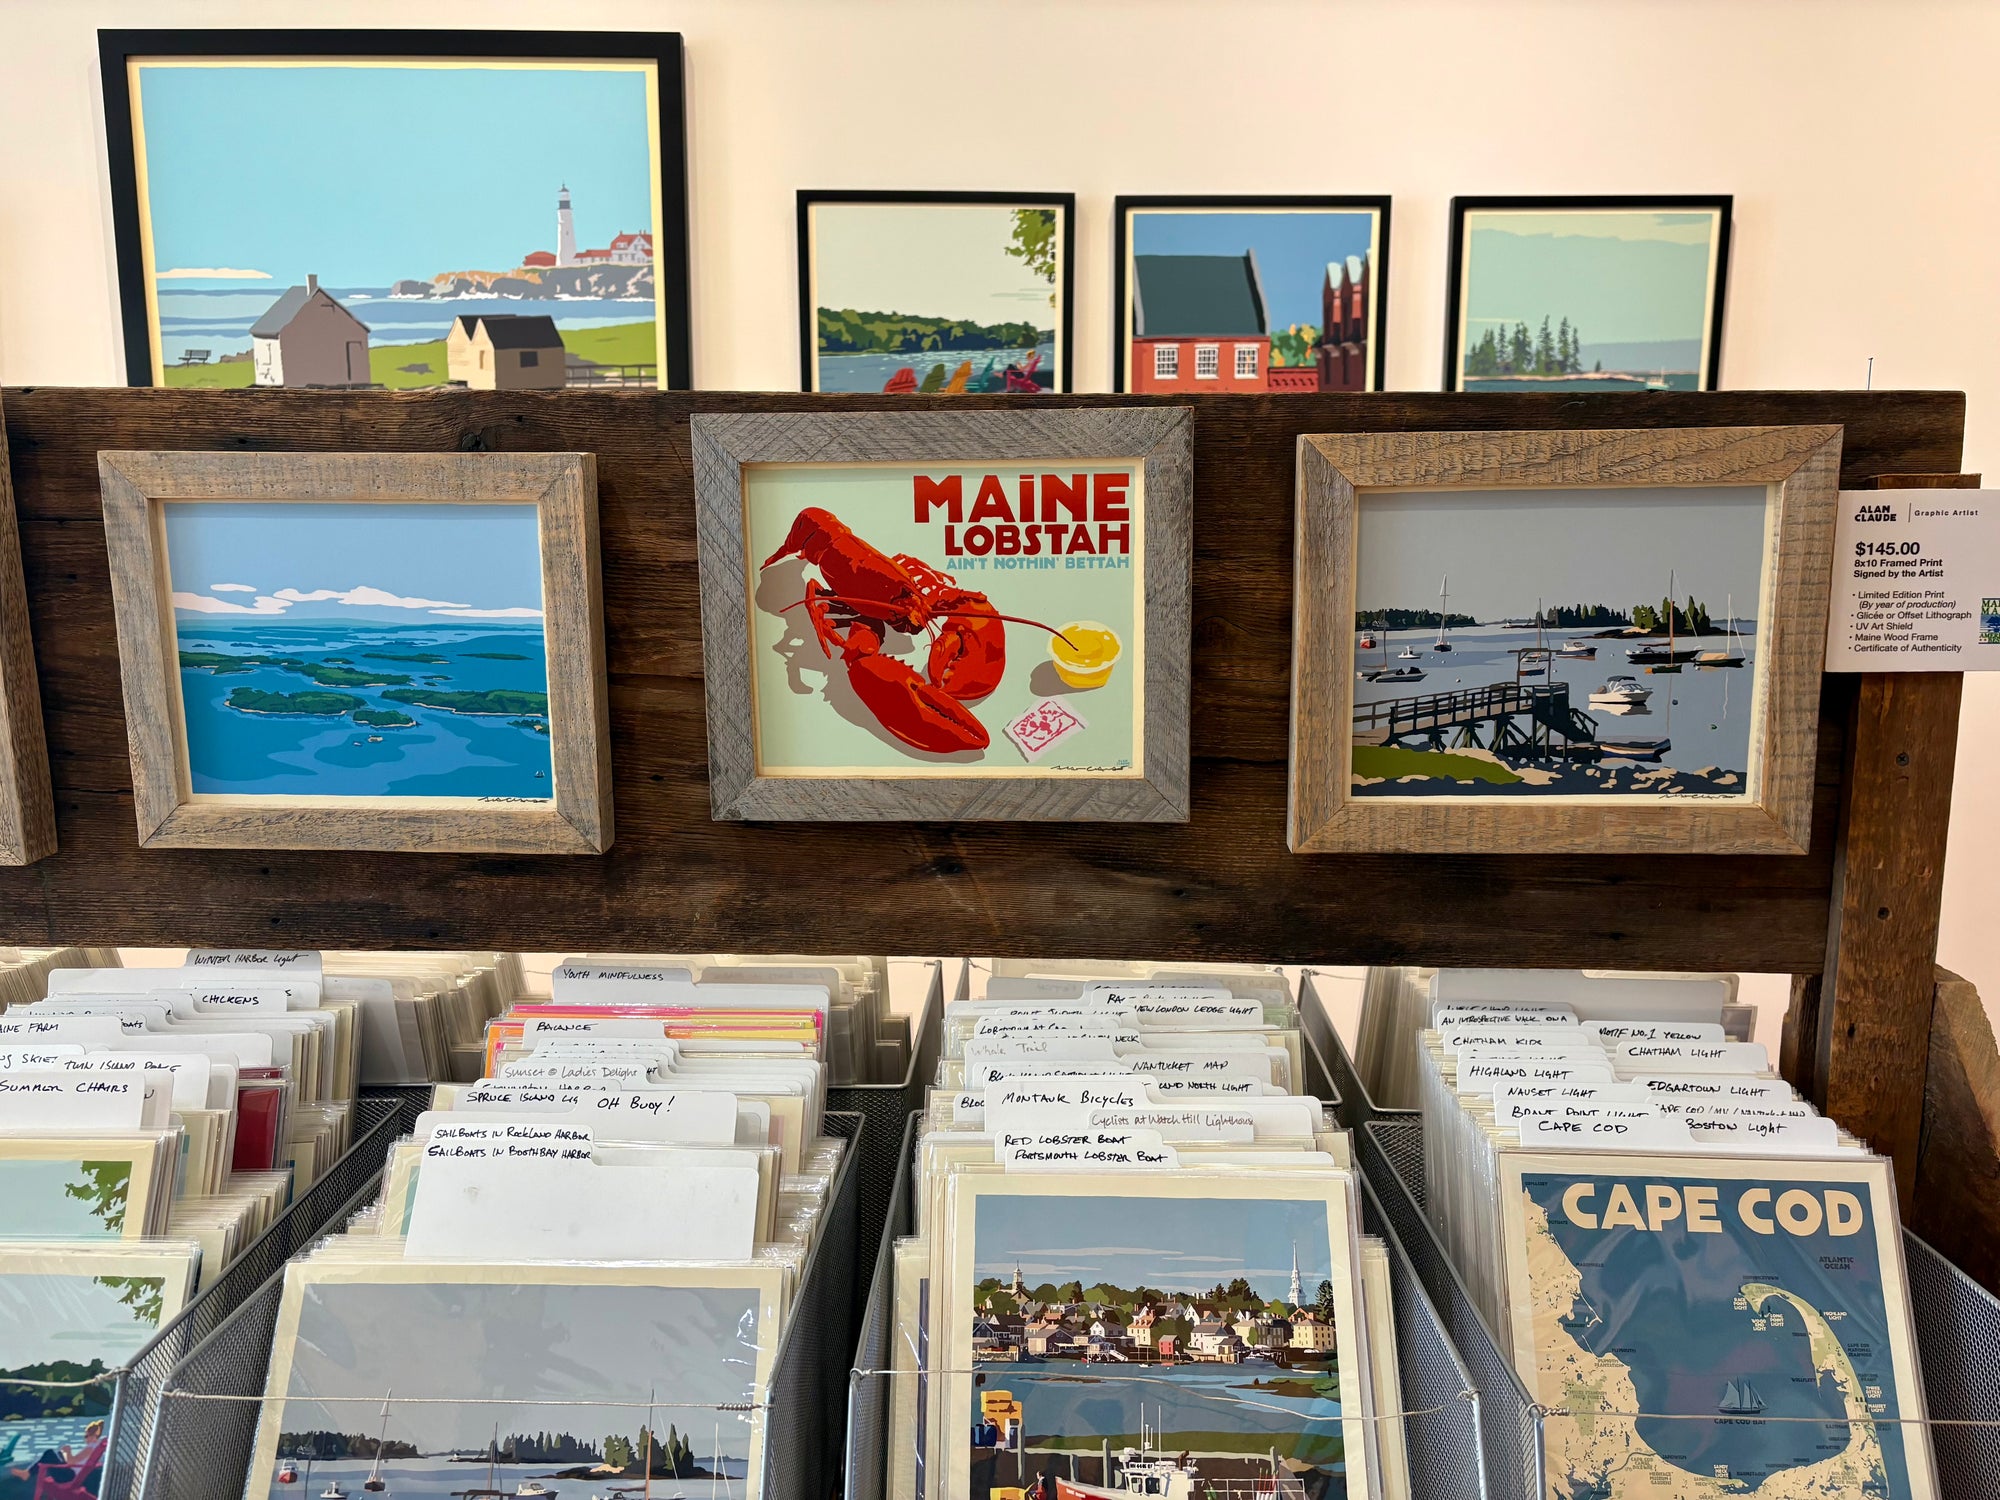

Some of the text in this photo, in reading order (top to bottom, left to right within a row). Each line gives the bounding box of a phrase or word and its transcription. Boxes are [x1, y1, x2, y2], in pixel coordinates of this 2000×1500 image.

[1860, 505, 1890, 513] ALAN
[1914, 509, 1949, 517] Graphic
[1854, 514, 1897, 522] CLAUDE
[945, 523, 1130, 556] LOBSTAH
[1855, 541, 1920, 557] $145.00
[946, 557, 1129, 570] AIN'T NOTHIN' BETTAH
[1854, 559, 1943, 567] 8x10 Framed Print
[1853, 570, 1885, 579] Signed
[1888, 570, 1899, 579] by
[1858, 590, 1945, 599] Limited Edition Print
[1859, 600, 1956, 610] (By year of production)
[1856, 611, 1884, 620] Glicée
[1897, 611, 1923, 619] Offset
[1926, 611, 1972, 621] Lithograph
[1886, 622, 1913, 630] Shield
[1855, 633, 1938, 641] Maine Wood Frame
[1854, 644, 1962, 653] Certificate of Authenticity
[194, 954, 231, 966] WINTER
[563, 968, 664, 982] YOUTH MINDFULNESS
[202, 995, 260, 1005] CHICKENS
[1155, 1005, 1189, 1014] LONDON
[1194, 1005, 1229, 1014] LEDGE
[28, 1023, 59, 1034] FARM
[536, 1021, 599, 1032] BALANCE
[1452, 1037, 1507, 1046] CHATHAM
[1628, 1047, 1727, 1058] CHATHAM LIGHT
[1133, 1060, 1229, 1072] NANTUCKET MAP
[505, 1066, 545, 1078] Sunset
[561, 1066, 597, 1079] Ladies
[601, 1066, 639, 1081] Delight
[1469, 1065, 1574, 1080] HIGHLAND LIGHT
[76, 1081, 129, 1093] CHAIRS
[1222, 1083, 1253, 1092] LIGHT
[1508, 1087, 1599, 1098] NAUSET LIGHT
[1647, 1080, 1771, 1097] EDGARTOWN LIGHT
[466, 1092, 512, 1103] SPRUCE
[597, 1097, 620, 1109] OH
[1002, 1091, 1071, 1105] MONTAUK
[1091, 1114, 1130, 1127] Cyclists
[1134, 1115, 1145, 1125] at
[1539, 1121, 1628, 1133] CAPE COD
[492, 1129, 502, 1139] IN
[1004, 1134, 1132, 1147] RED LOBSTER BOAT
[492, 1147, 505, 1157] IN
[1014, 1150, 1078, 1161] PORTSMOUTH
[1084, 1151, 1132, 1162] LOBSTER
[1562, 1182, 1864, 1237] CAPE COD
